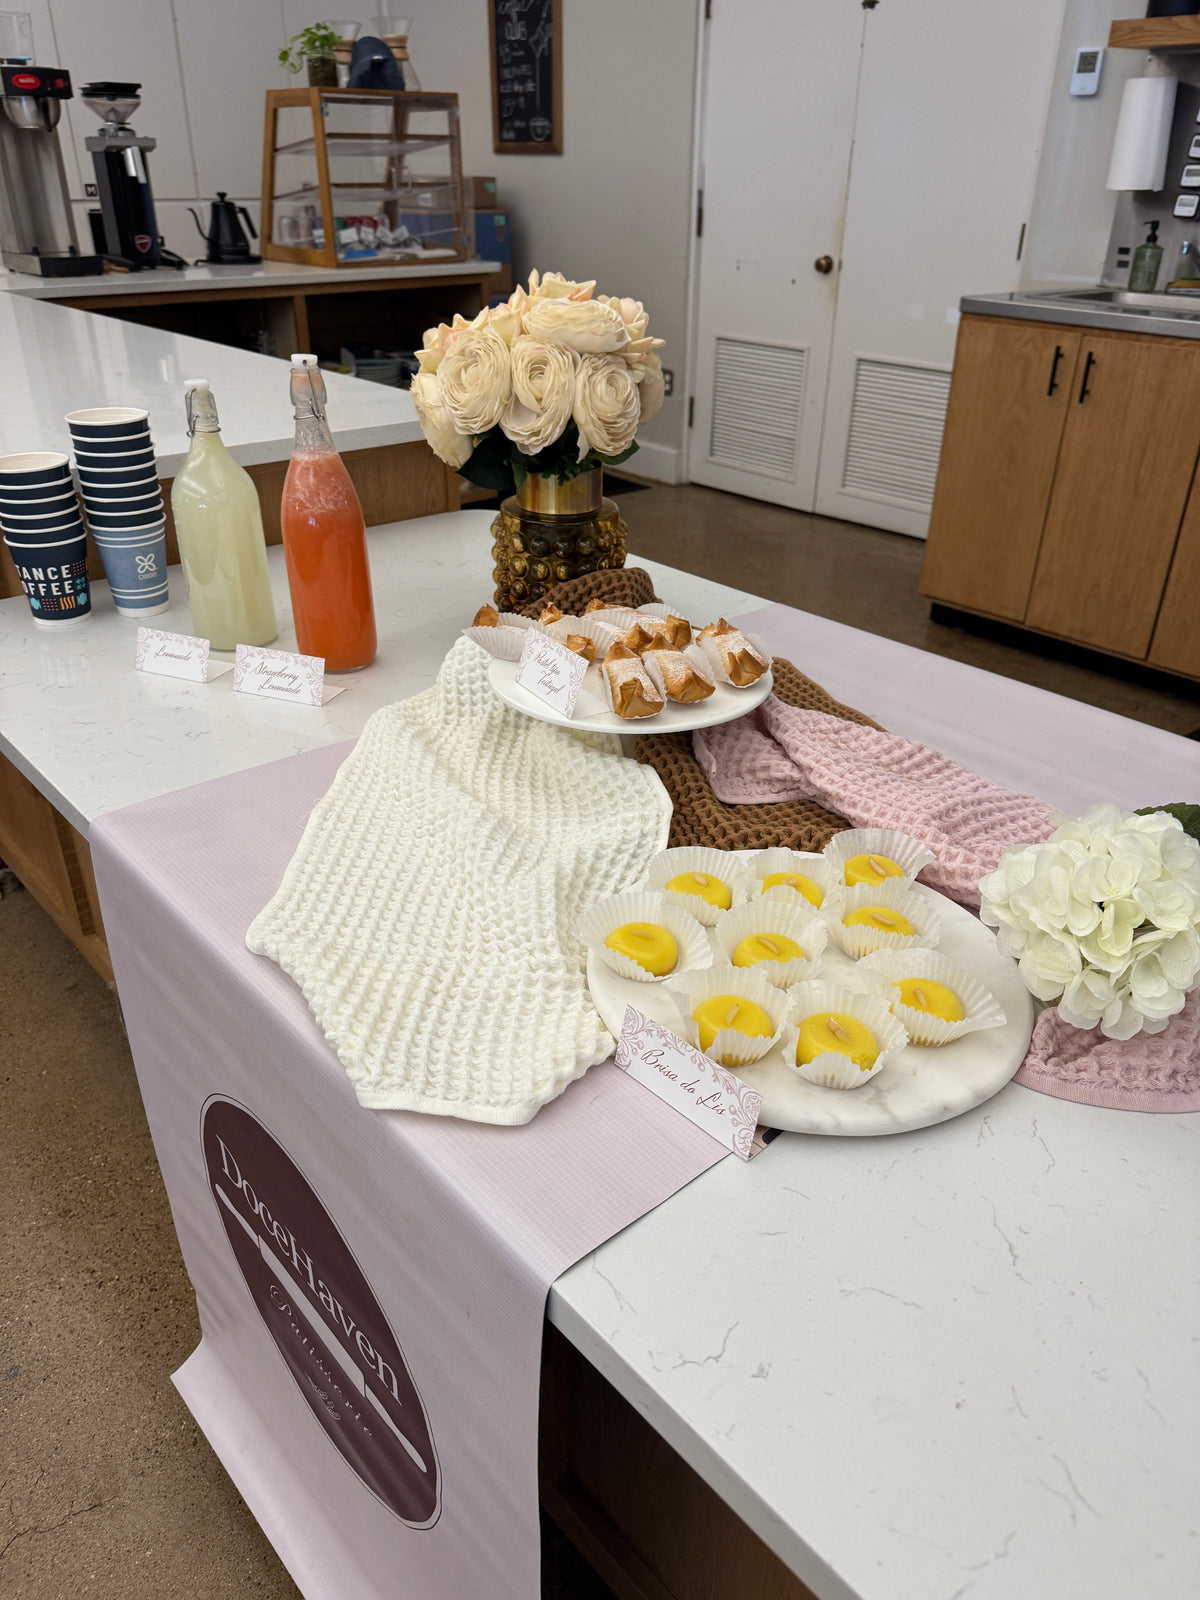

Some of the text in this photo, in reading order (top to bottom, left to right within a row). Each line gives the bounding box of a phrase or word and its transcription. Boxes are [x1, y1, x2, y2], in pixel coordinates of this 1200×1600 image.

[154, 644, 193, 661] Lemonade
[249, 661, 300, 687] Strawberry
[257, 676, 303, 695] Lemonade
[640, 1049, 727, 1116] Brisa do Lis
[215, 1134, 403, 1406] DoceHaven
